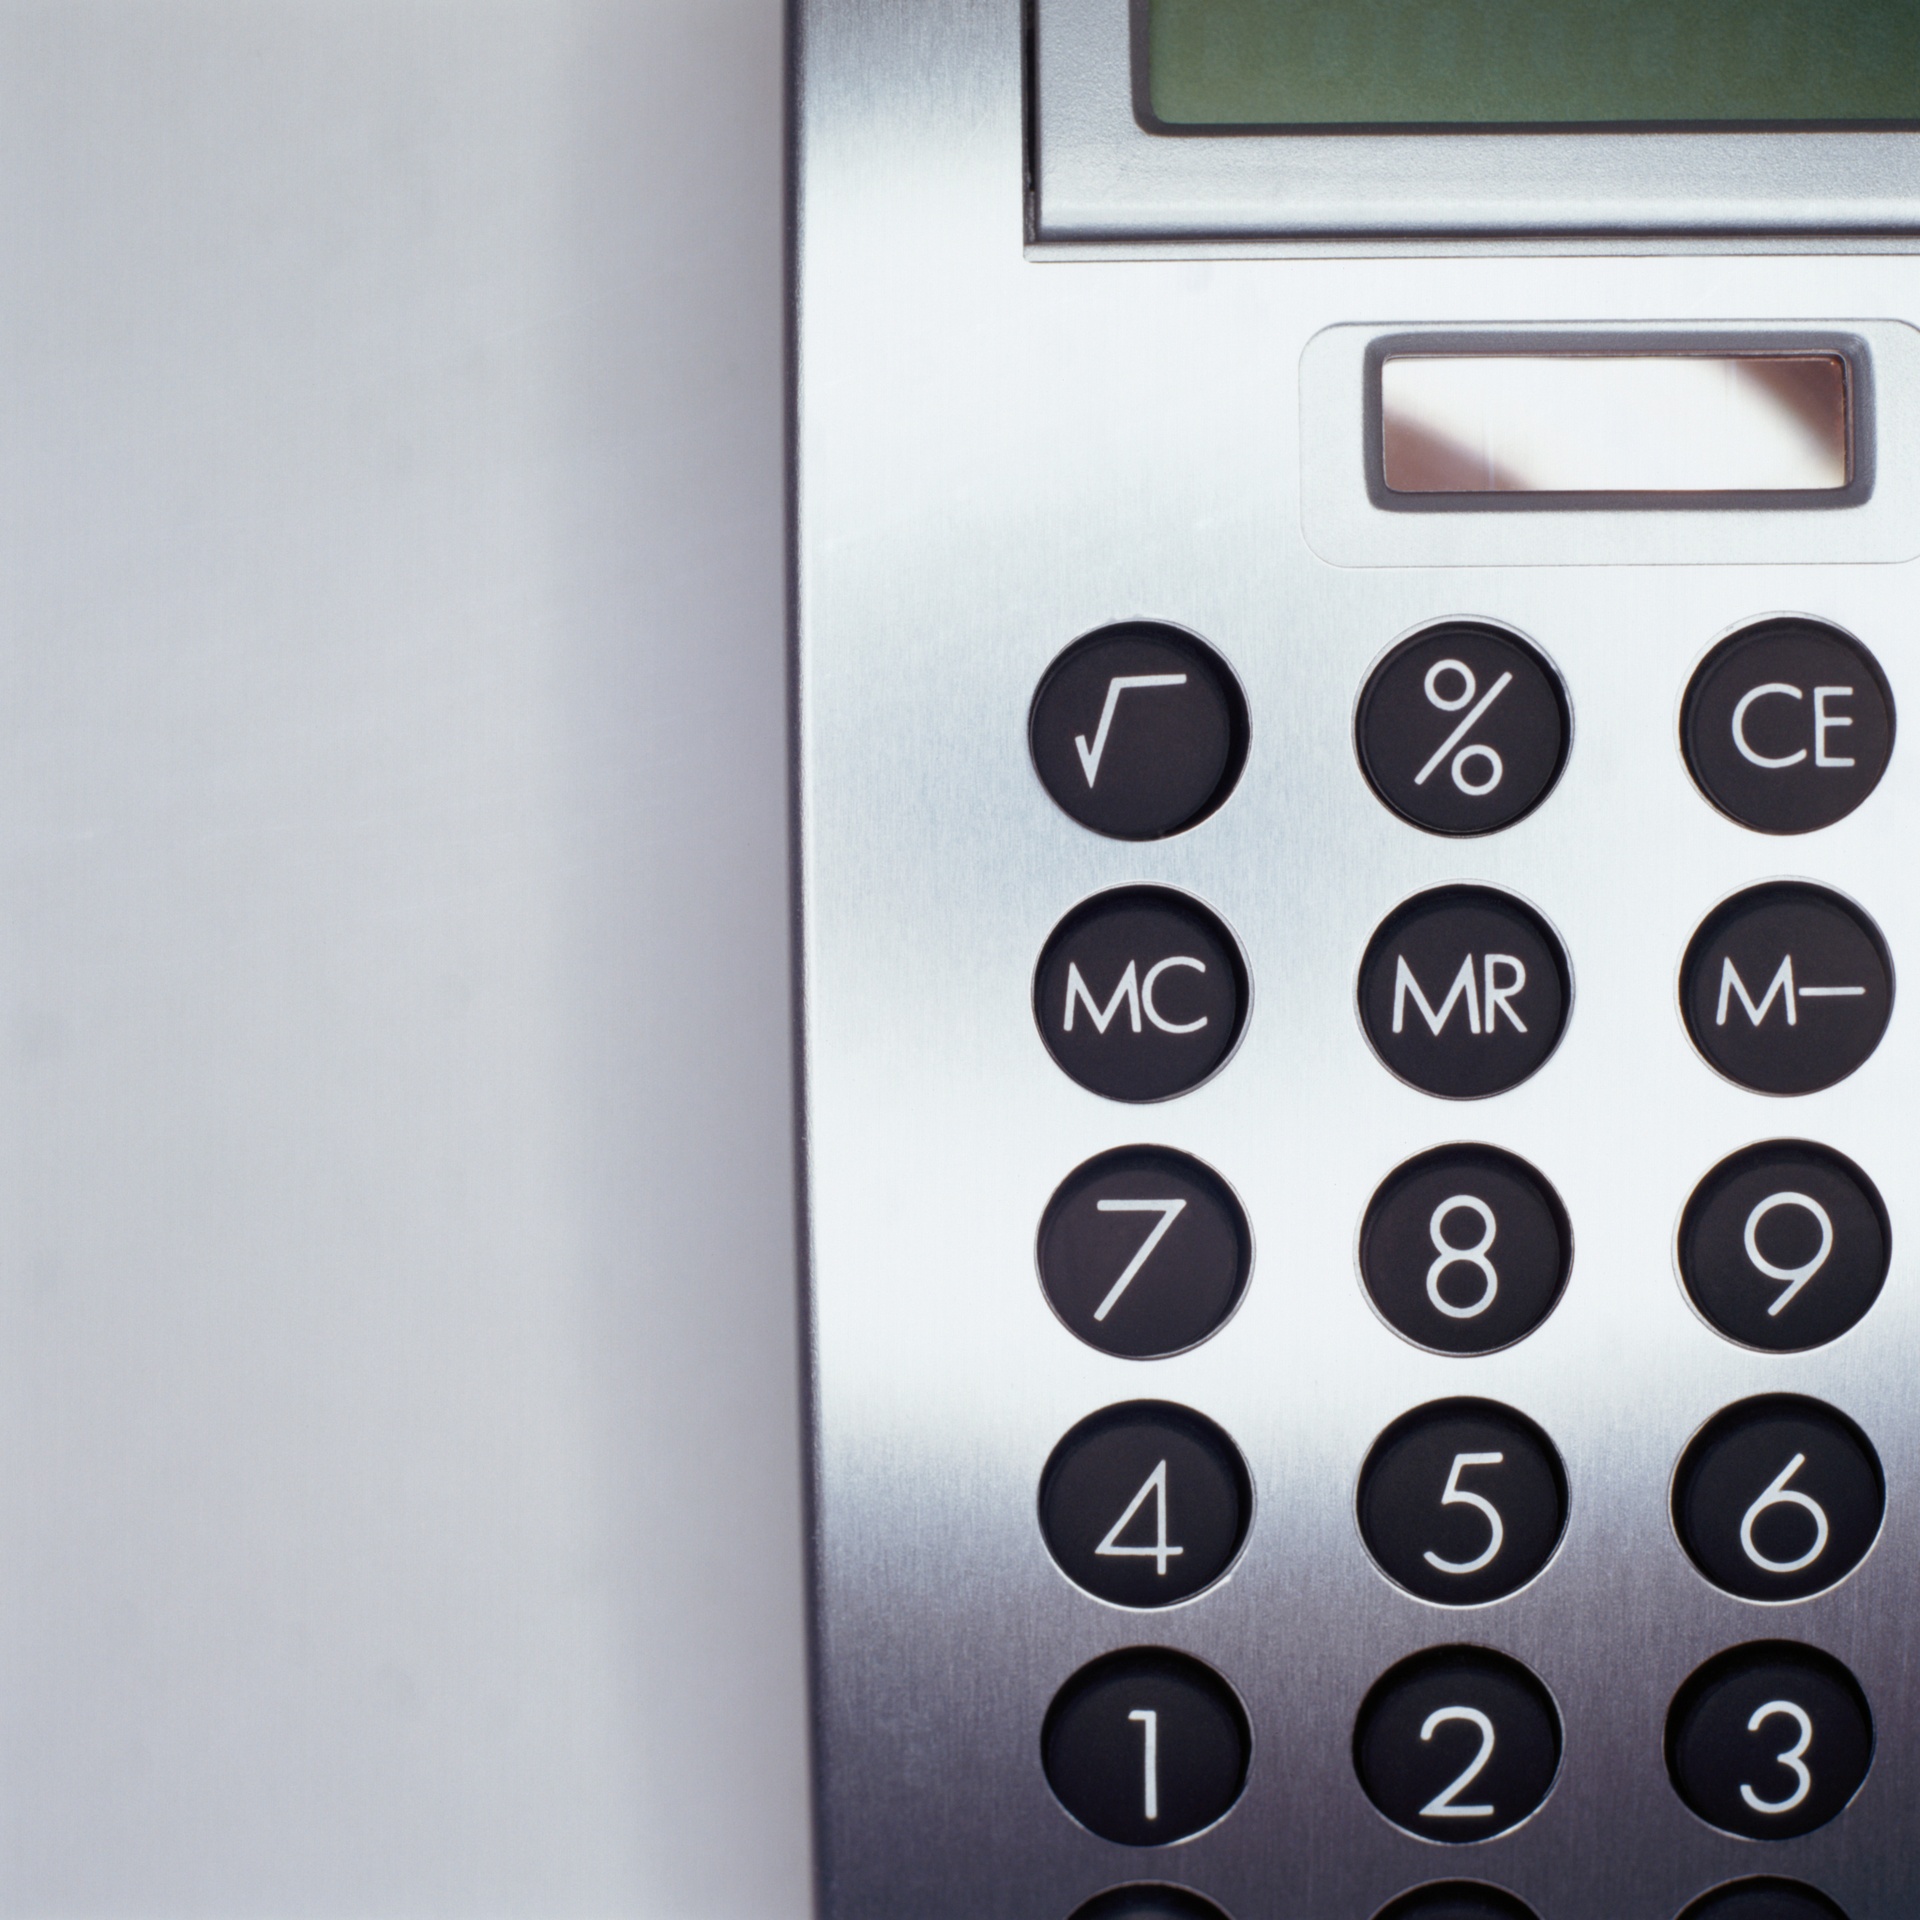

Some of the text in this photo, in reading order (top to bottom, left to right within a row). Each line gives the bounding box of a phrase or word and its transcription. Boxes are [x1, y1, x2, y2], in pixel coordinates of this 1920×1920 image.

[1413, 658, 1513, 797] %
[1731, 682, 1856, 769] CE
[1063, 955, 1208, 1035] MC
[1391, 952, 1528, 1037] MR
[1093, 1198, 1188, 1322] 7
[1425, 1194, 1499, 1319] 8
[1743, 1191, 1834, 1317] 9
[1094, 1459, 1184, 1576] 4
[1423, 1451, 1504, 1574] 5
[1739, 1452, 1829, 1573] 6
[1128, 1709, 1158, 1820] 1
[1419, 1705, 1495, 1817] 2
[1740, 1700, 1813, 1814] 3
